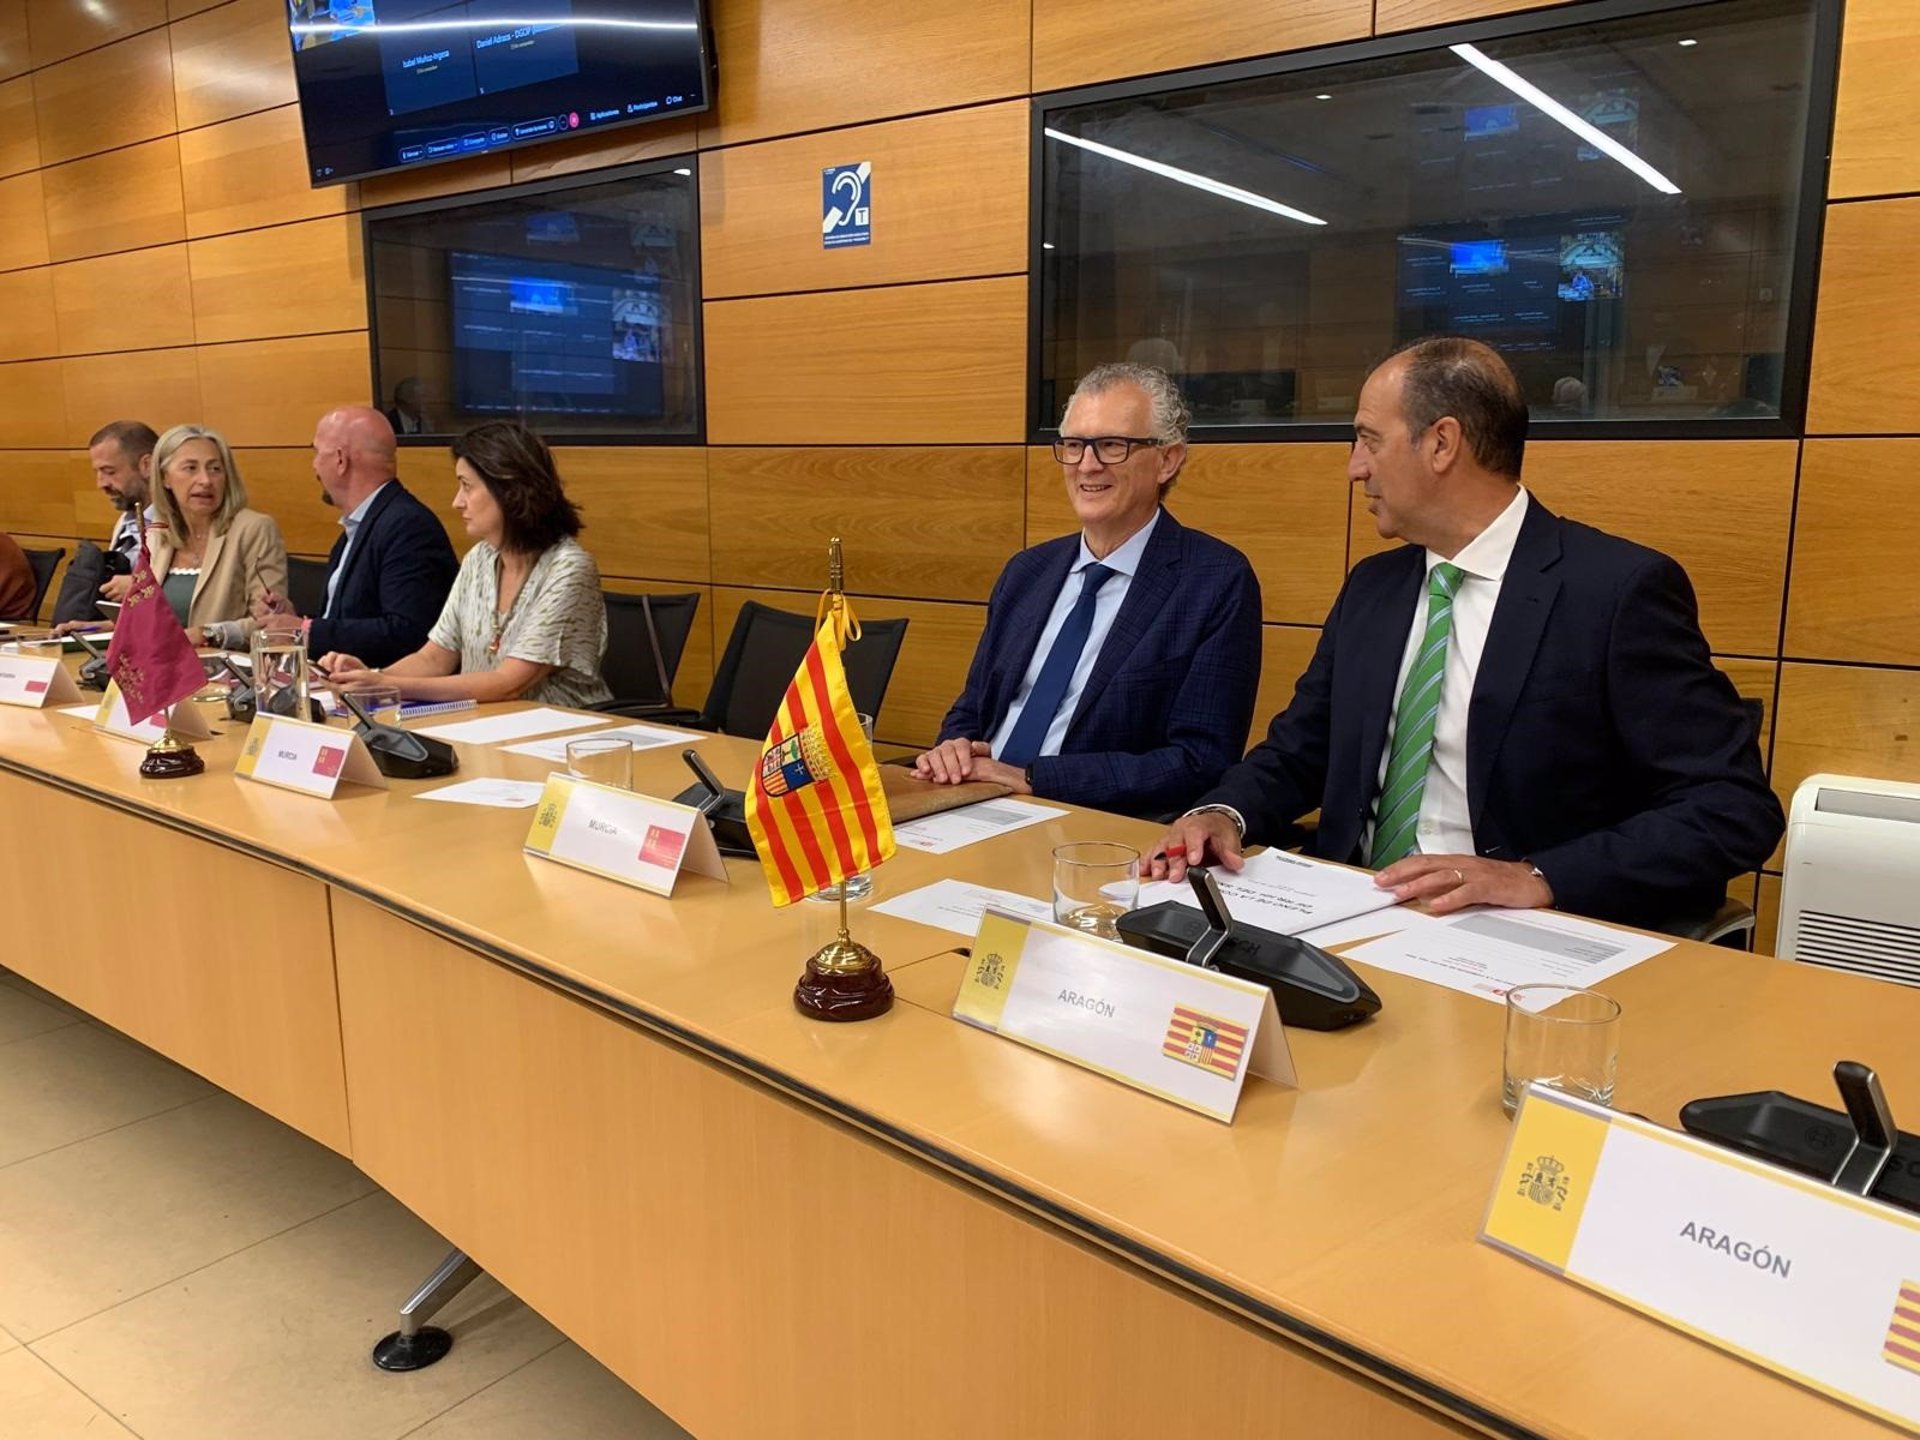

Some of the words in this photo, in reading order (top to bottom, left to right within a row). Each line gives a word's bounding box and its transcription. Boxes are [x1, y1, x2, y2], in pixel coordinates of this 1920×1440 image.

[858, 209, 866, 223] T
[588, 818, 618, 835] MURCIA
[1057, 988, 1116, 1019] ARAGÓN
[1679, 1220, 1792, 1279] ARAGÓN
